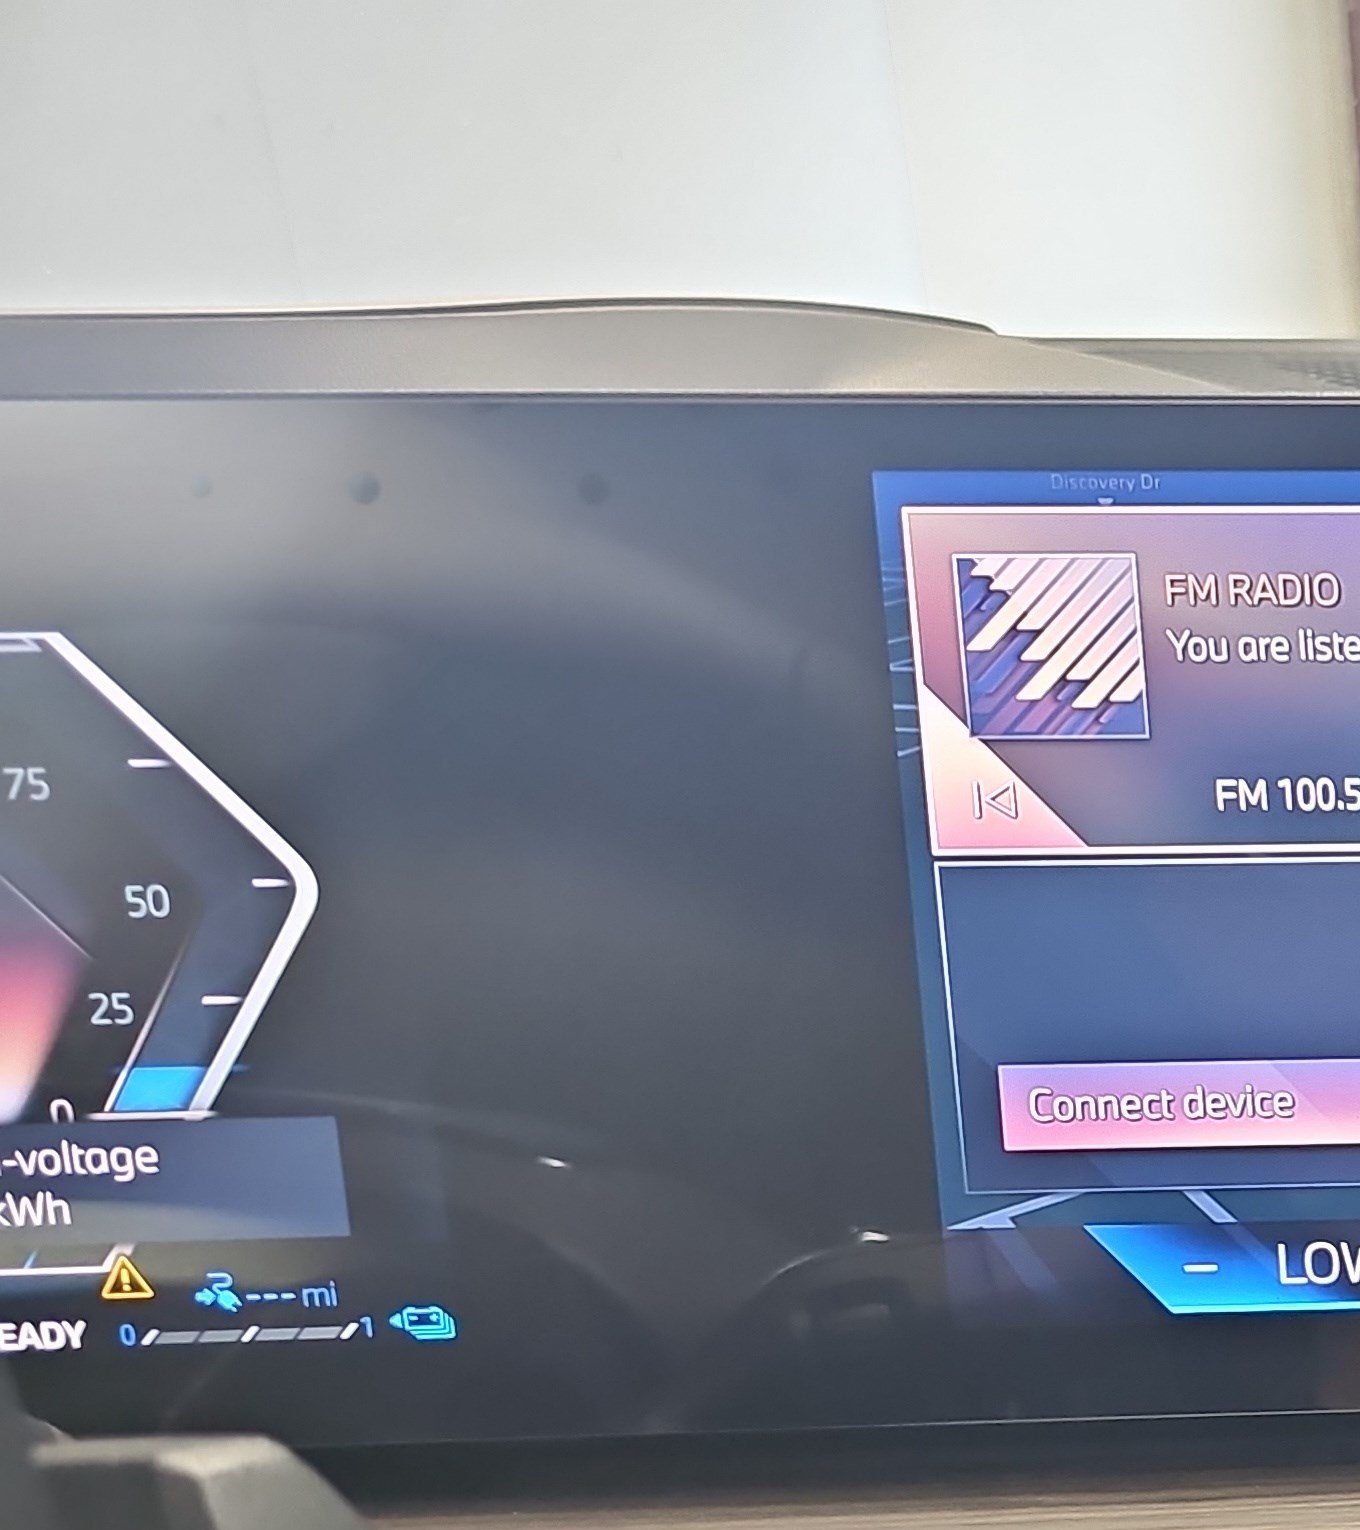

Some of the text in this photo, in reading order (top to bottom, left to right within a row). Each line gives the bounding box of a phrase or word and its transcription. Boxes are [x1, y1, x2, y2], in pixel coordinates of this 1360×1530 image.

[1050, 473, 1161, 495] Discovery Dr
[1165, 572, 1341, 606] FM RADIO
[1166, 629, 1228, 663] You
[1239, 635, 1291, 663] are
[3, 766, 51, 801] 75
[1215, 779, 1268, 812] FM
[125, 884, 171, 918] 50
[89, 993, 134, 1026] 25
[1029, 1086, 1294, 1124] Connect device
[0, 1139, 159, 1182] -voltage
[302, 1282, 338, 1308] mi
[119, 1323, 137, 1347] 0
[360, 1317, 375, 1339] 1
